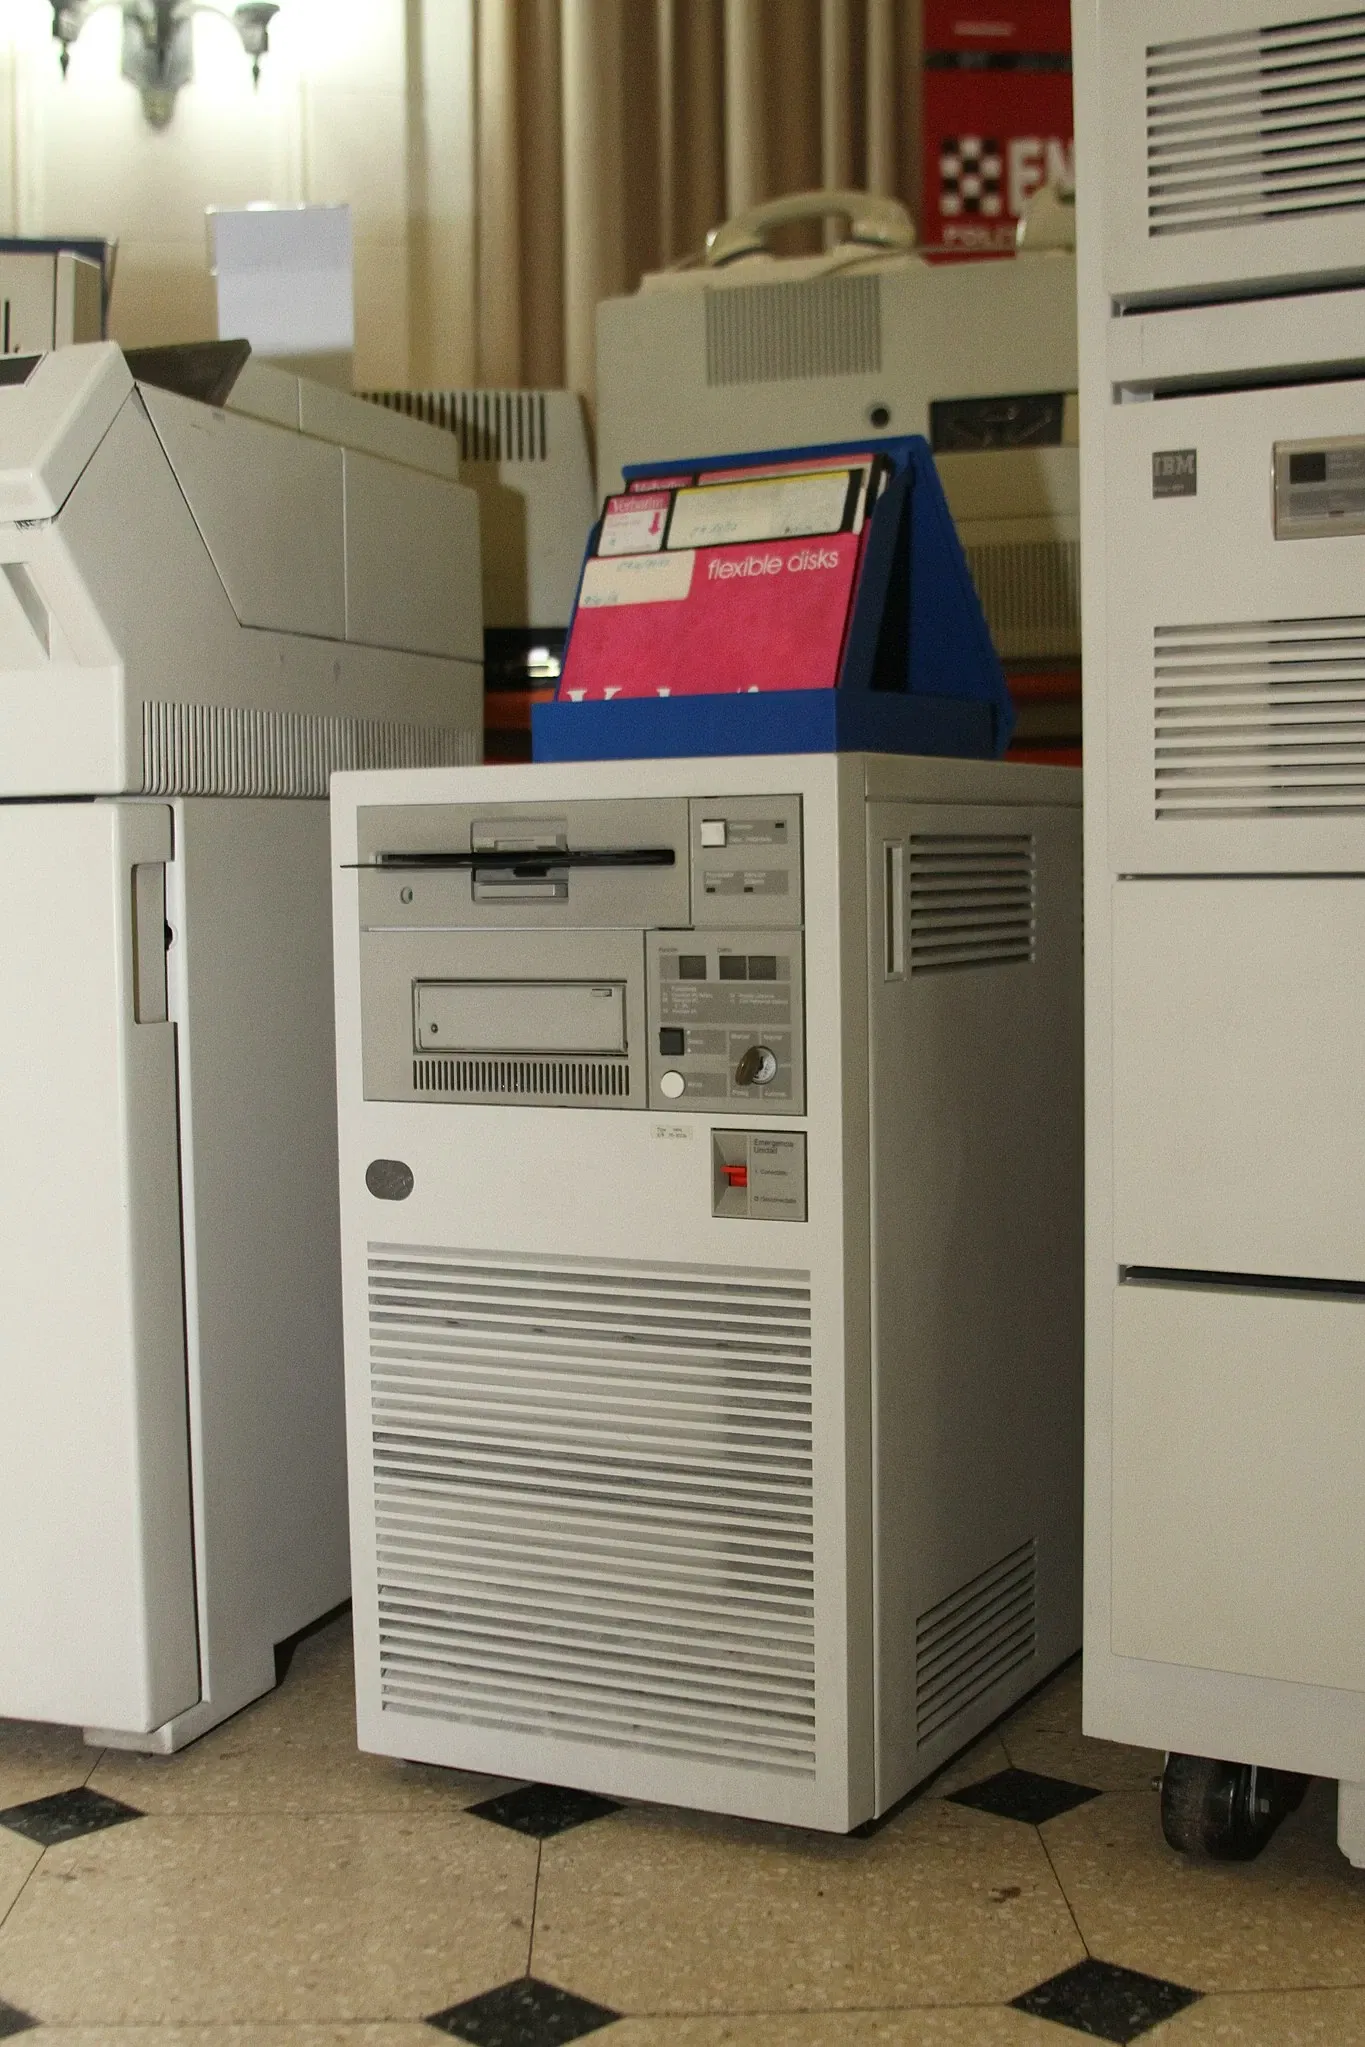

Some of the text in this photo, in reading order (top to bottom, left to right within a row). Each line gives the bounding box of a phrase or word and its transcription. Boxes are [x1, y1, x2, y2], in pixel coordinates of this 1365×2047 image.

[1154, 454, 1195, 477] IBM
[707, 548, 839, 580] flexible disks
